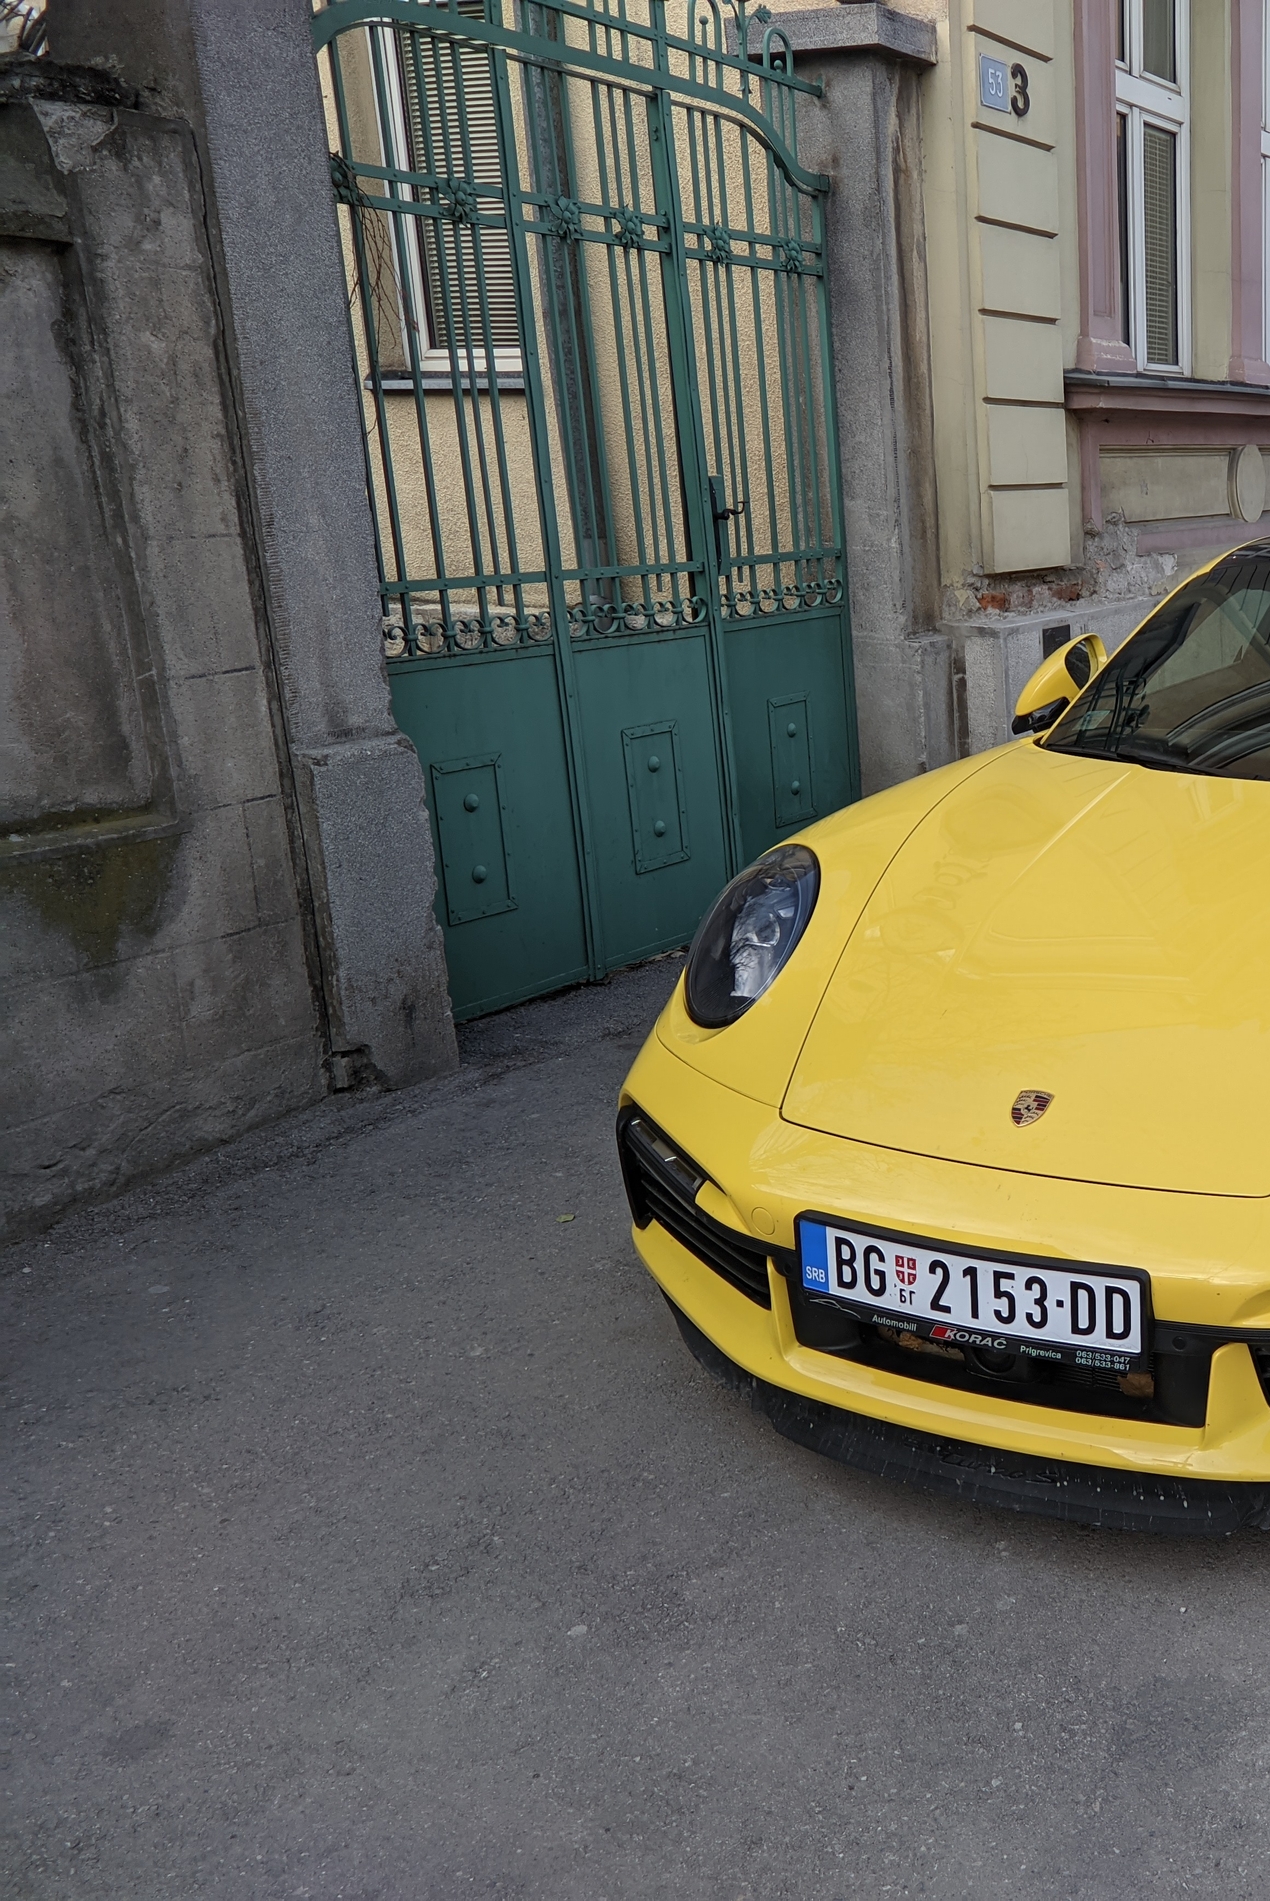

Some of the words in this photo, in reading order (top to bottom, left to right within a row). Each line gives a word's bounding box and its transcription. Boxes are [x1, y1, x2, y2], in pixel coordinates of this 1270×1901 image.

[988, 68, 1003, 97] 53
[1011, 62, 1030, 117] 3
[805, 1266, 826, 1283] SRB
[834, 1236, 887, 1298] BG
[872, 1314, 917, 1332] Automobili
[944, 1328, 1007, 1350] KORAĆ
[1020, 1345, 1062, 1360] Prigrevica
[1075, 1357, 1130, 1371] 063/533-861
[1076, 1350, 1130, 1364] 063/533-047
